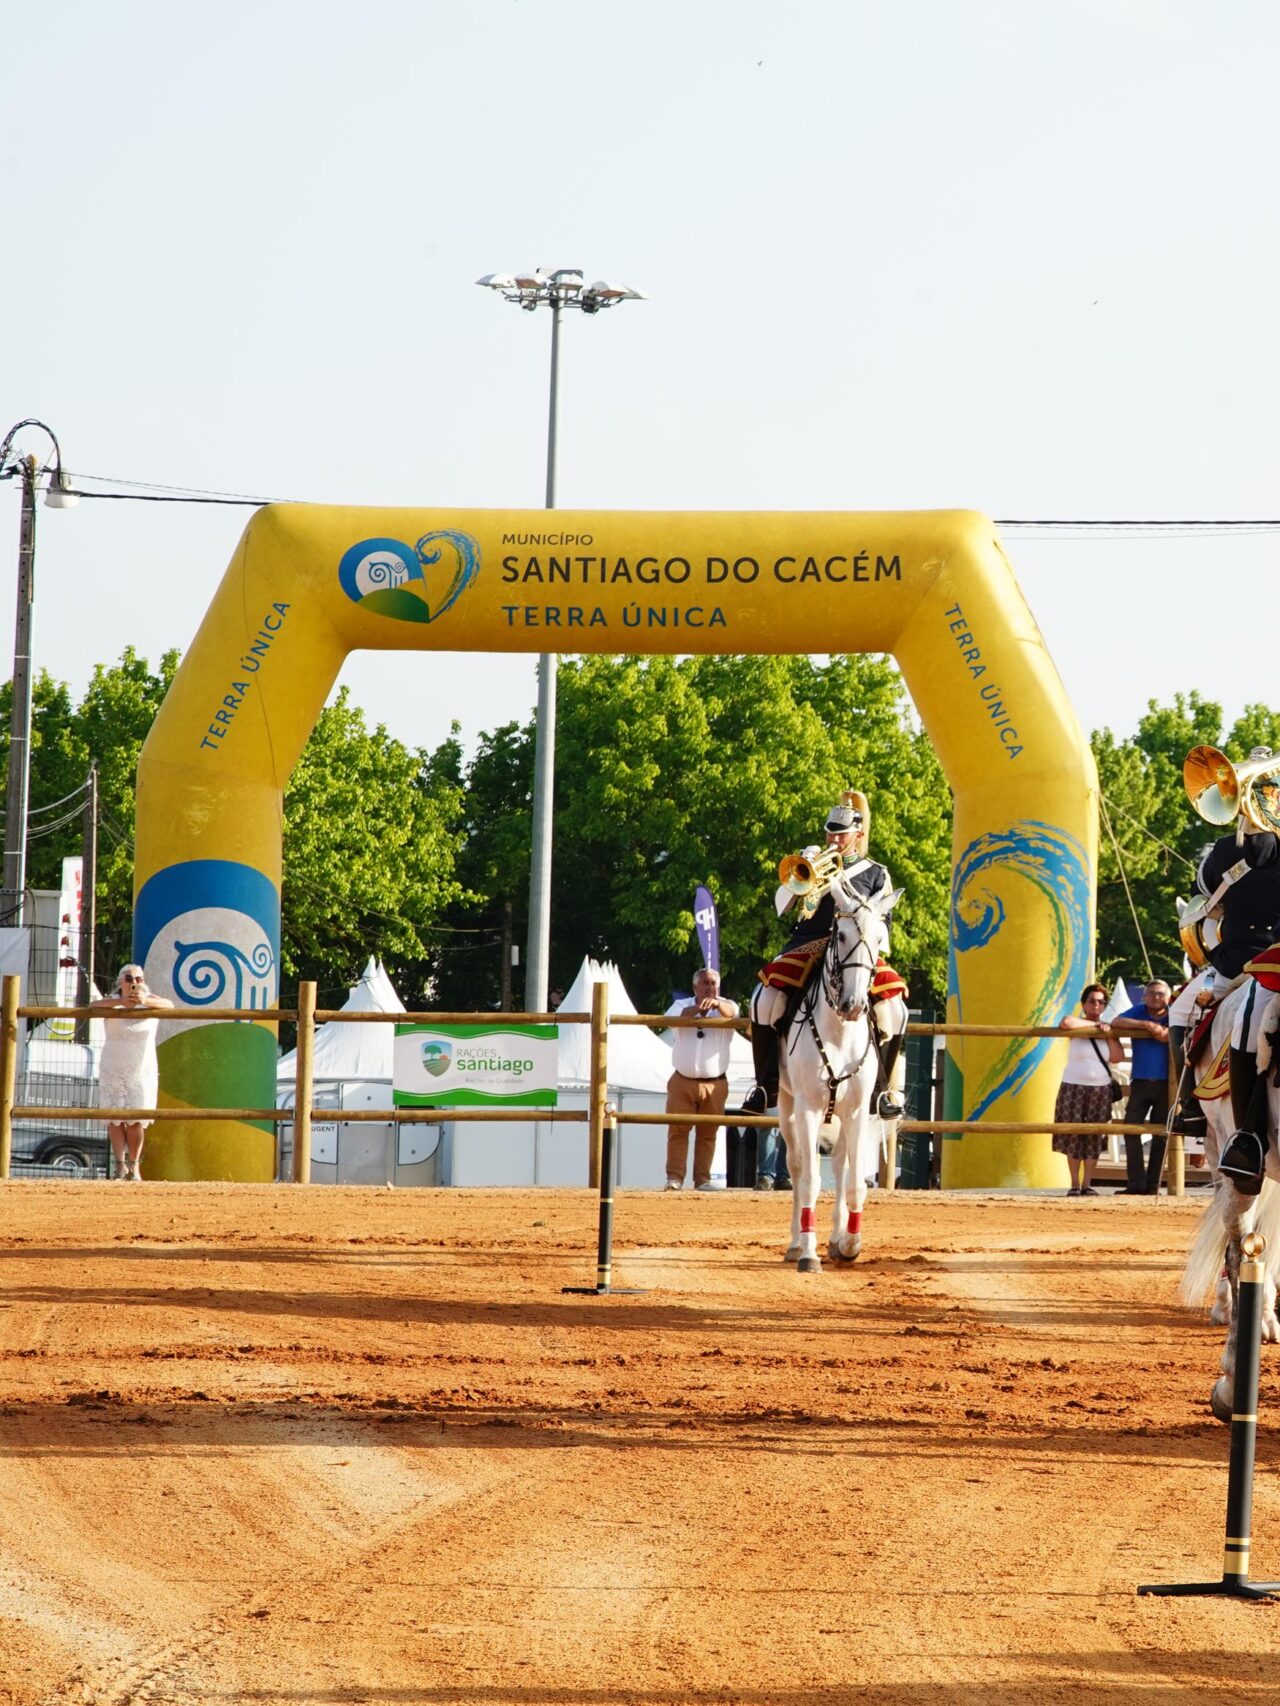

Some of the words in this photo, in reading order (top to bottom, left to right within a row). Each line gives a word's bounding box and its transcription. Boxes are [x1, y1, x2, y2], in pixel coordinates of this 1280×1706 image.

[501, 532, 594, 546] MUNICÍPIO
[501, 556, 691, 584] SANTIAGO
[706, 557, 760, 584] DO
[773, 550, 902, 584] CACÉM
[501, 606, 609, 627] TERRA
[622, 602, 728, 628] ÚNICA
[200, 681, 250, 749] TERRA
[241, 602, 291, 673] ÚNICA
[944, 602, 987, 680] TERRA
[980, 684, 1024, 760] ÚNICA
[456, 1047, 497, 1059] RAÇÕES
[457, 1056, 533, 1075] santiago
